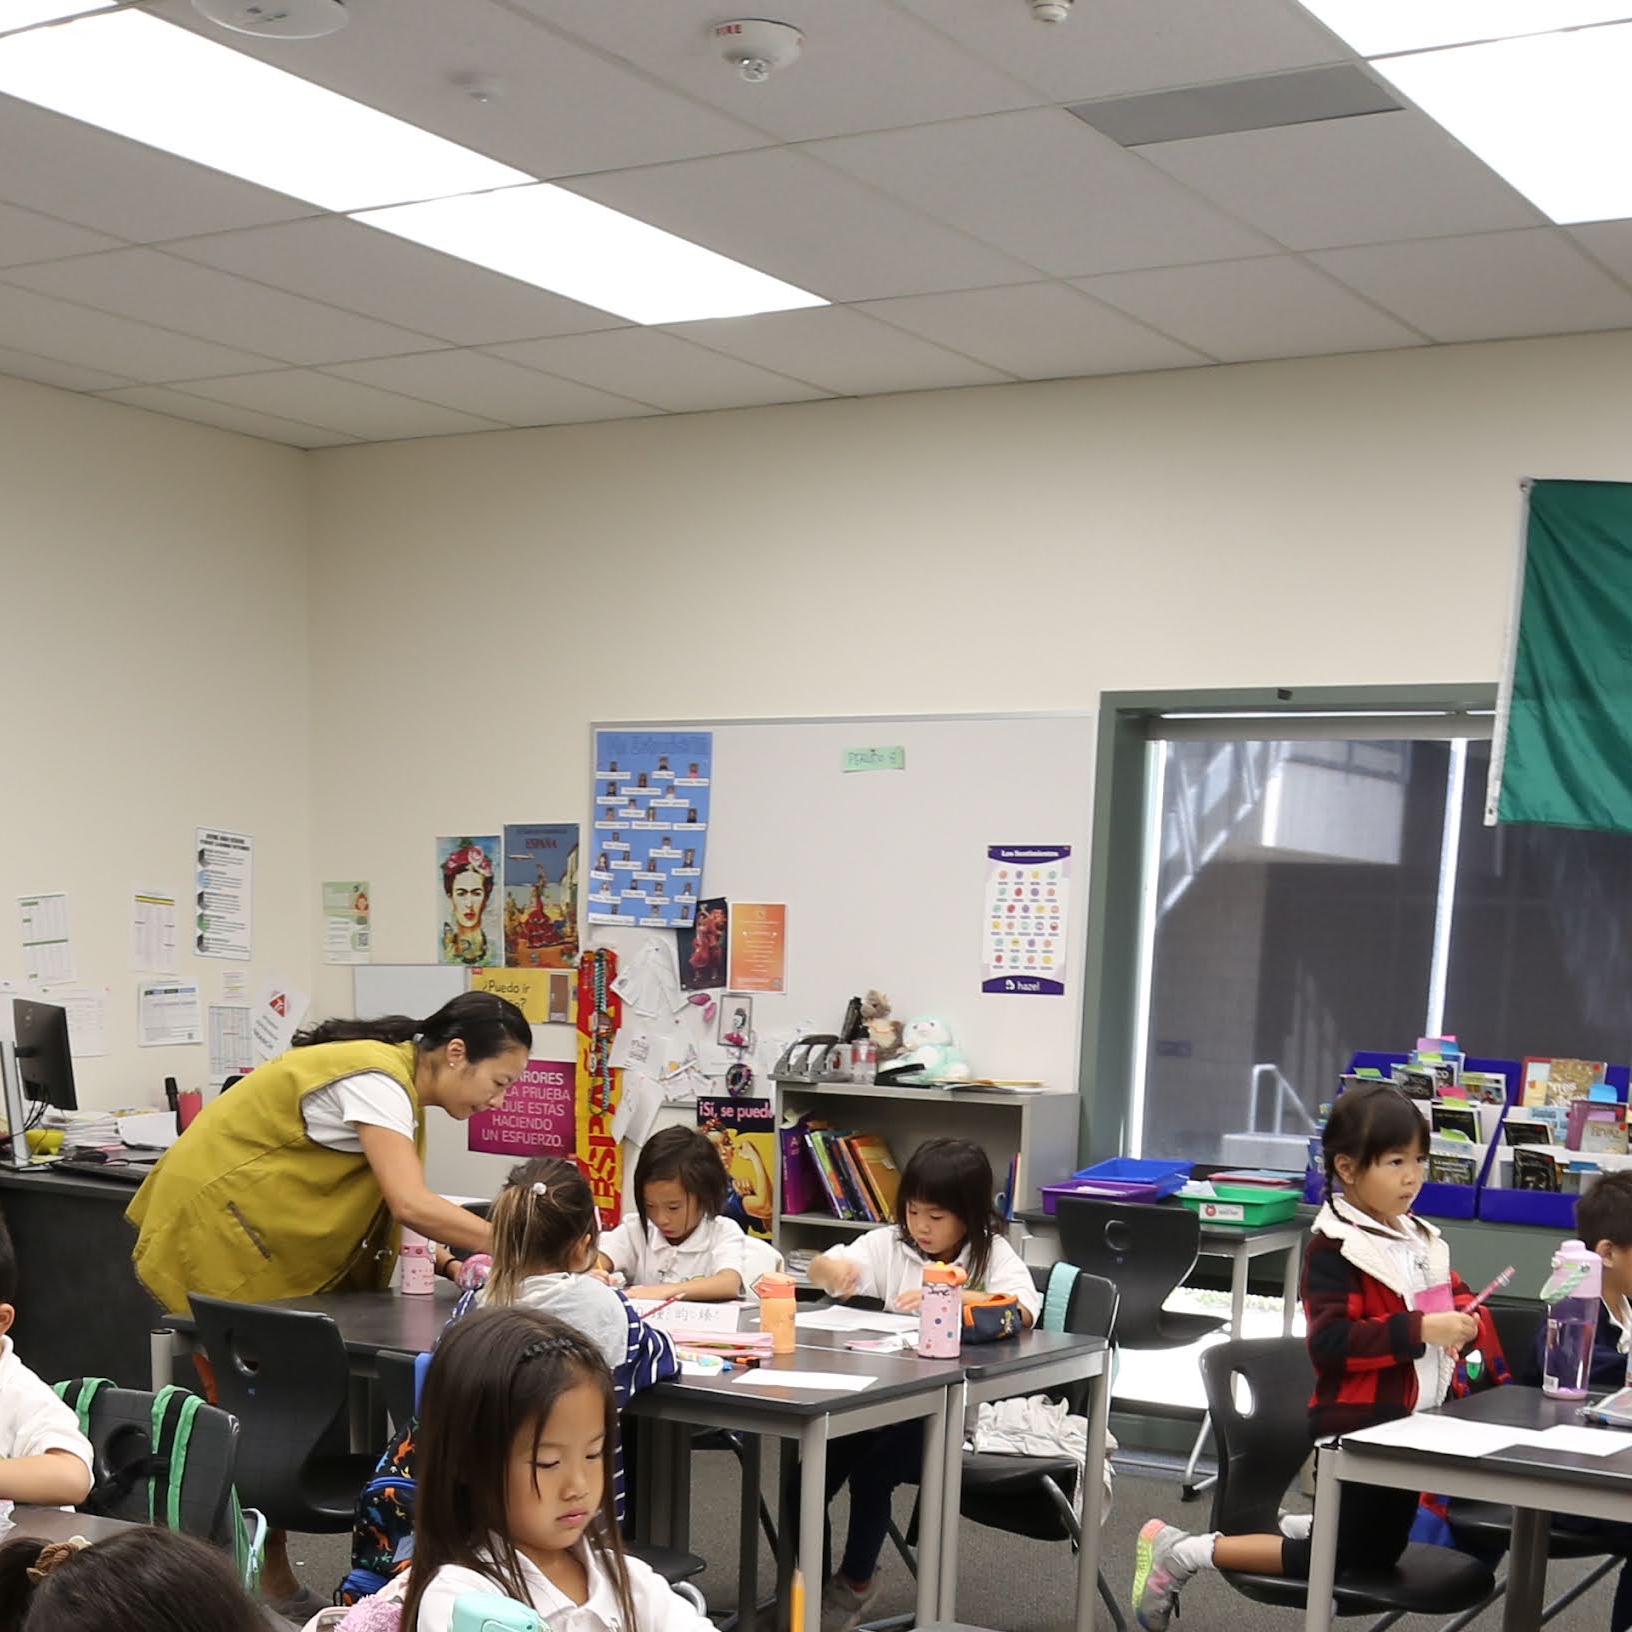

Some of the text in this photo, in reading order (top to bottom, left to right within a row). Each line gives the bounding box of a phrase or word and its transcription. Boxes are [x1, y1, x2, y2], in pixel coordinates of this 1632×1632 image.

[482, 979, 532, 995] ¿Puedo ir
[1017, 981, 1040, 991] hazel
[522, 1086, 572, 1102] PRUEBA
[720, 1107, 735, 1118] se
[492, 1116, 553, 1131] HACIENDO
[481, 1128, 565, 1148] UN ESFUERZO.
